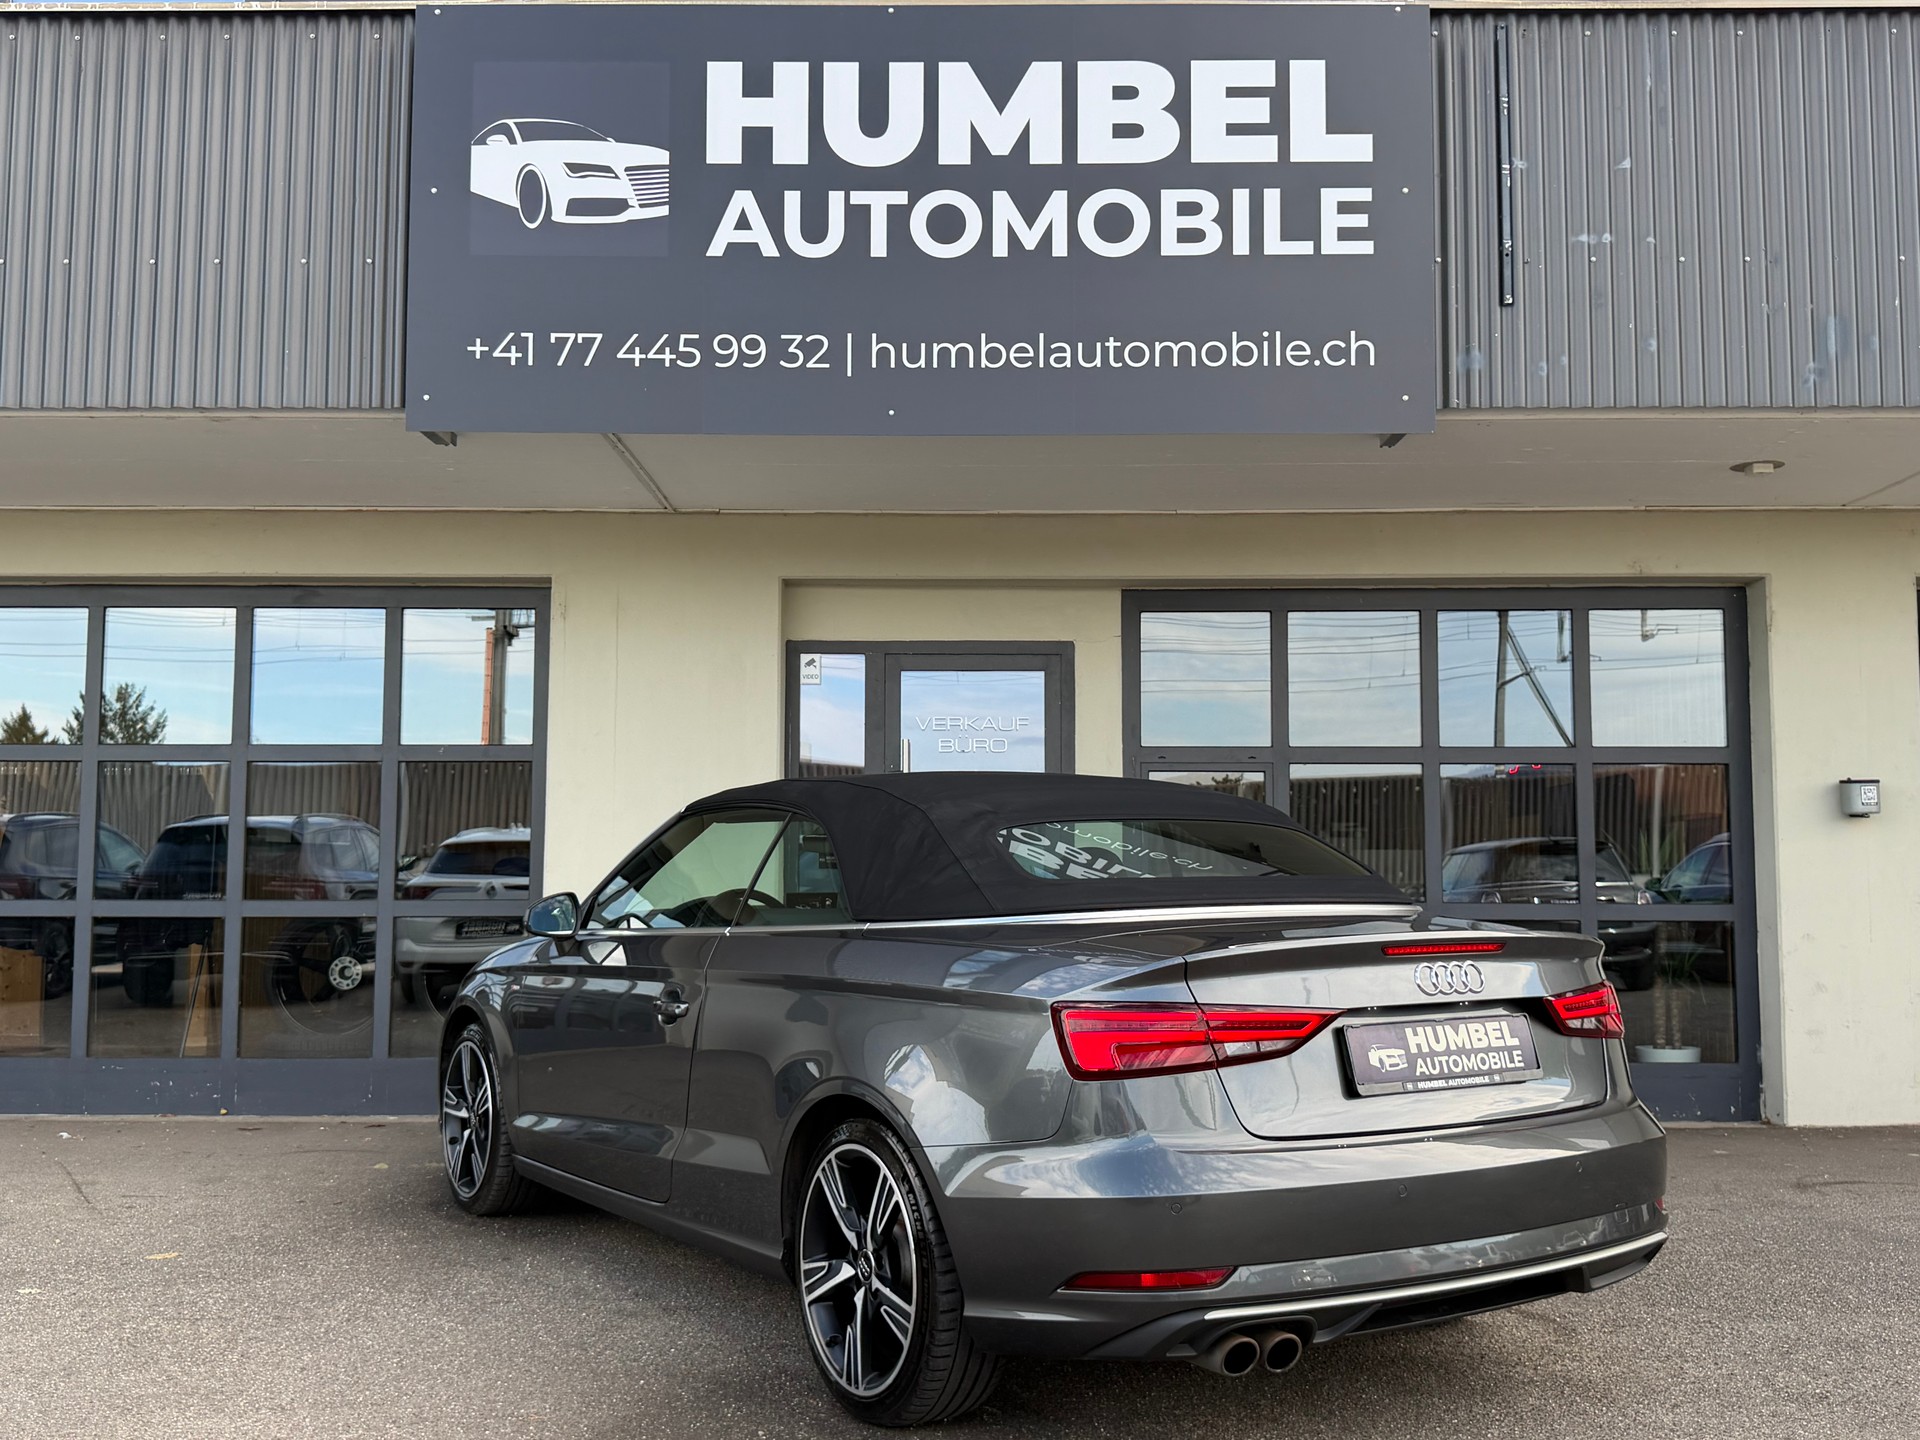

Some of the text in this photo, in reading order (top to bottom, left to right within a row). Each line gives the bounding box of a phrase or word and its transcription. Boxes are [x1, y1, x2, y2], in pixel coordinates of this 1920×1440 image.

[705, 59, 1374, 168] HUMBEL
[705, 187, 1375, 259] AUTOMOBILE
[467, 332, 533, 366] +41
[551, 333, 603, 366] 77
[617, 334, 701, 367] 445
[713, 334, 766, 367] 99
[780, 335, 830, 368] 32
[872, 331, 1374, 368] humbelautomobile.ch
[916, 716, 1029, 731] VERKAUF
[938, 736, 1008, 753] BÜRO
[1404, 1021, 1520, 1054] HUMBEL
[1415, 1050, 1525, 1076] AUTOMOBILE
[1417, 1075, 1490, 1089] HUMBEL AUTOMOBILE
